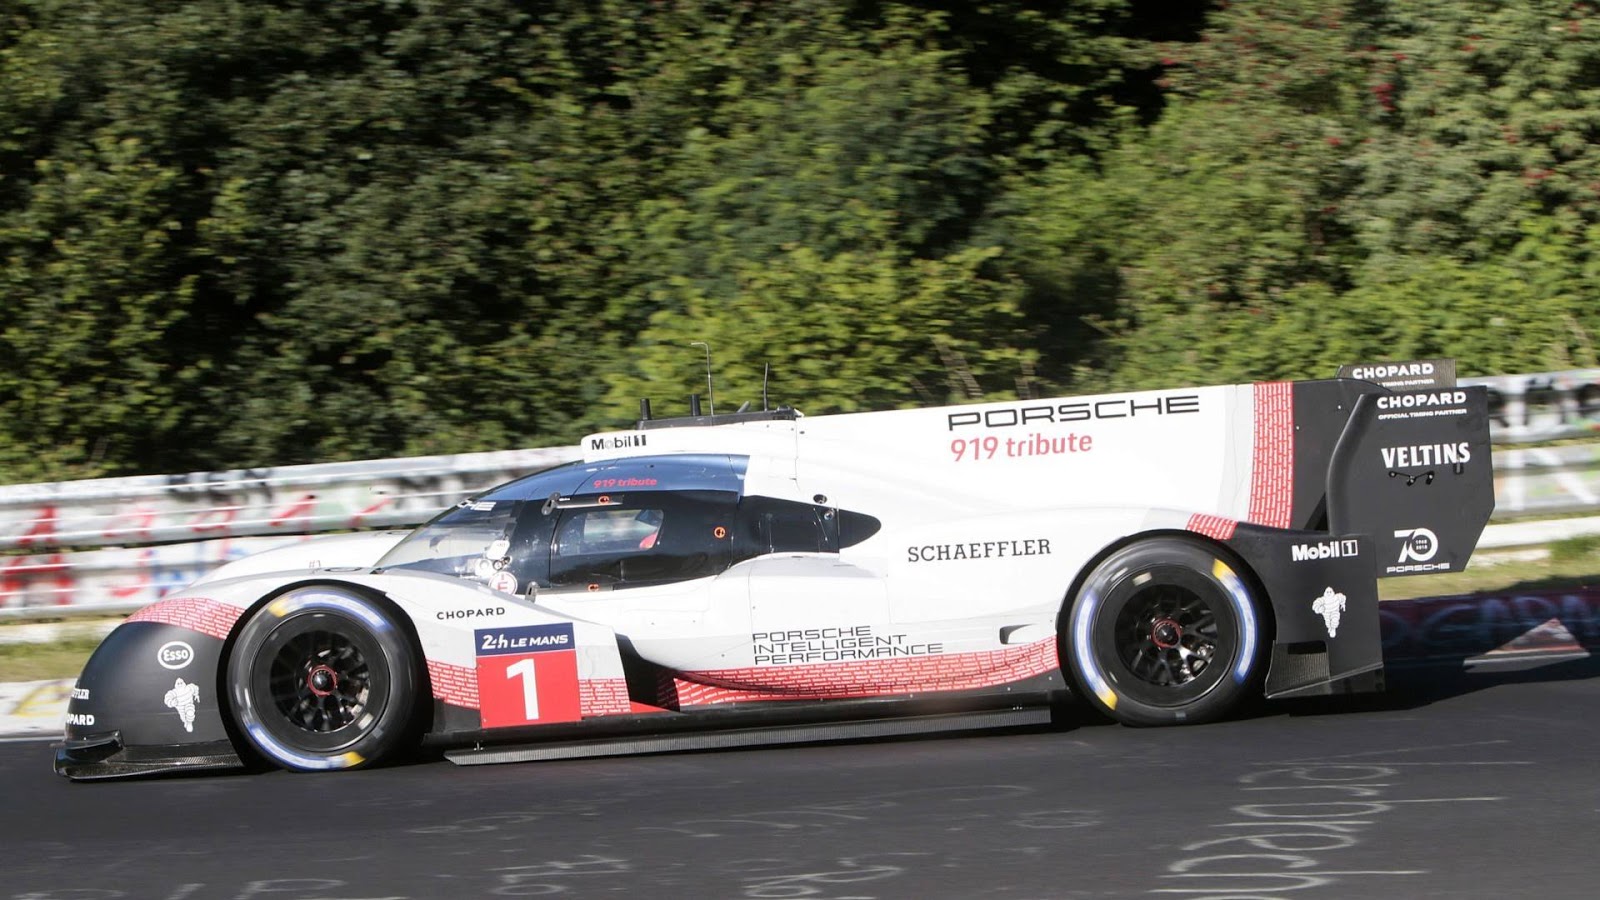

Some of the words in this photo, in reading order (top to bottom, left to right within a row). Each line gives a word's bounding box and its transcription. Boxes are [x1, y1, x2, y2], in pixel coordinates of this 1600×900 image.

[1352, 363, 1434, 380] CHOPARD
[1376, 391, 1467, 410] CHOPARD
[947, 395, 1200, 432] PORSCHE
[1378, 412, 1409, 420] OFFICIAL
[1409, 410, 1433, 418] TIMING
[1434, 408, 1467, 416] PARTNER
[591, 434, 632, 450] Mobil
[950, 436, 999, 462] 919
[1005, 432, 1093, 458] tribute
[1381, 442, 1471, 469] VELTINS
[594, 478, 615, 488] 919
[617, 477, 658, 488] tribute
[908, 538, 1051, 563] SCHAEFFLER
[1291, 541, 1340, 562] Mobil
[1394, 527, 1438, 563] 70
[1386, 562, 1450, 573] PORSCHE
[436, 607, 506, 621] CHOPARD
[481, 633, 508, 650] 24h
[510, 637, 527, 648] LE
[529, 634, 569, 646] MANS
[752, 625, 871, 643] PORSCHE
[752, 634, 907, 655] INTELLIGENT
[754, 643, 944, 665] PERFORMANCE
[506, 658, 540, 721] 1
